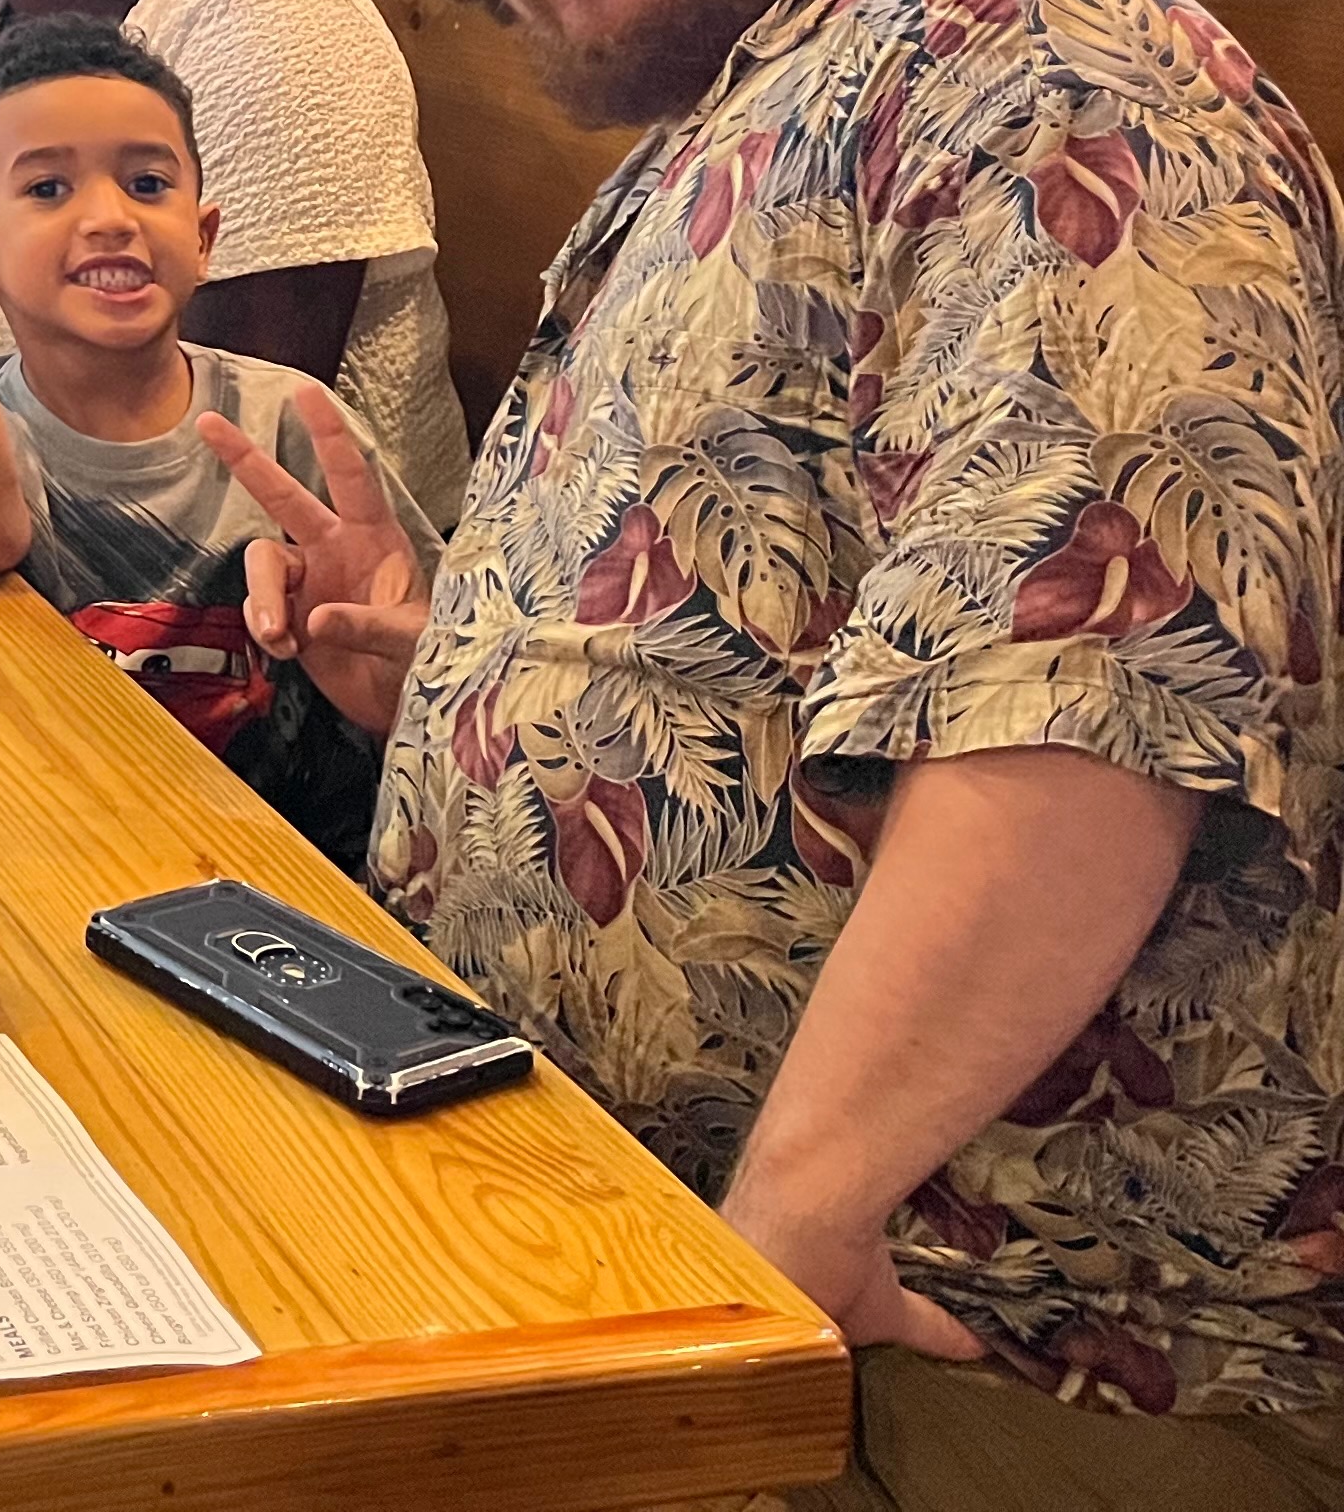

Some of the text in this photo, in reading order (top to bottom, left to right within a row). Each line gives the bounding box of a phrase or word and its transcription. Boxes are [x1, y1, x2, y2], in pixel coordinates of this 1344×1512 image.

[3, 1288, 41, 1323] Chicken
[31, 1287, 68, 1320] Cheese
[28, 1324, 62, 1354] Grilled
[62, 1331, 89, 1351] Mac
[86, 1323, 116, 1348] Fried
[100, 1307, 142, 1346] Chicken
[129, 1310, 168, 1345] Cheese
